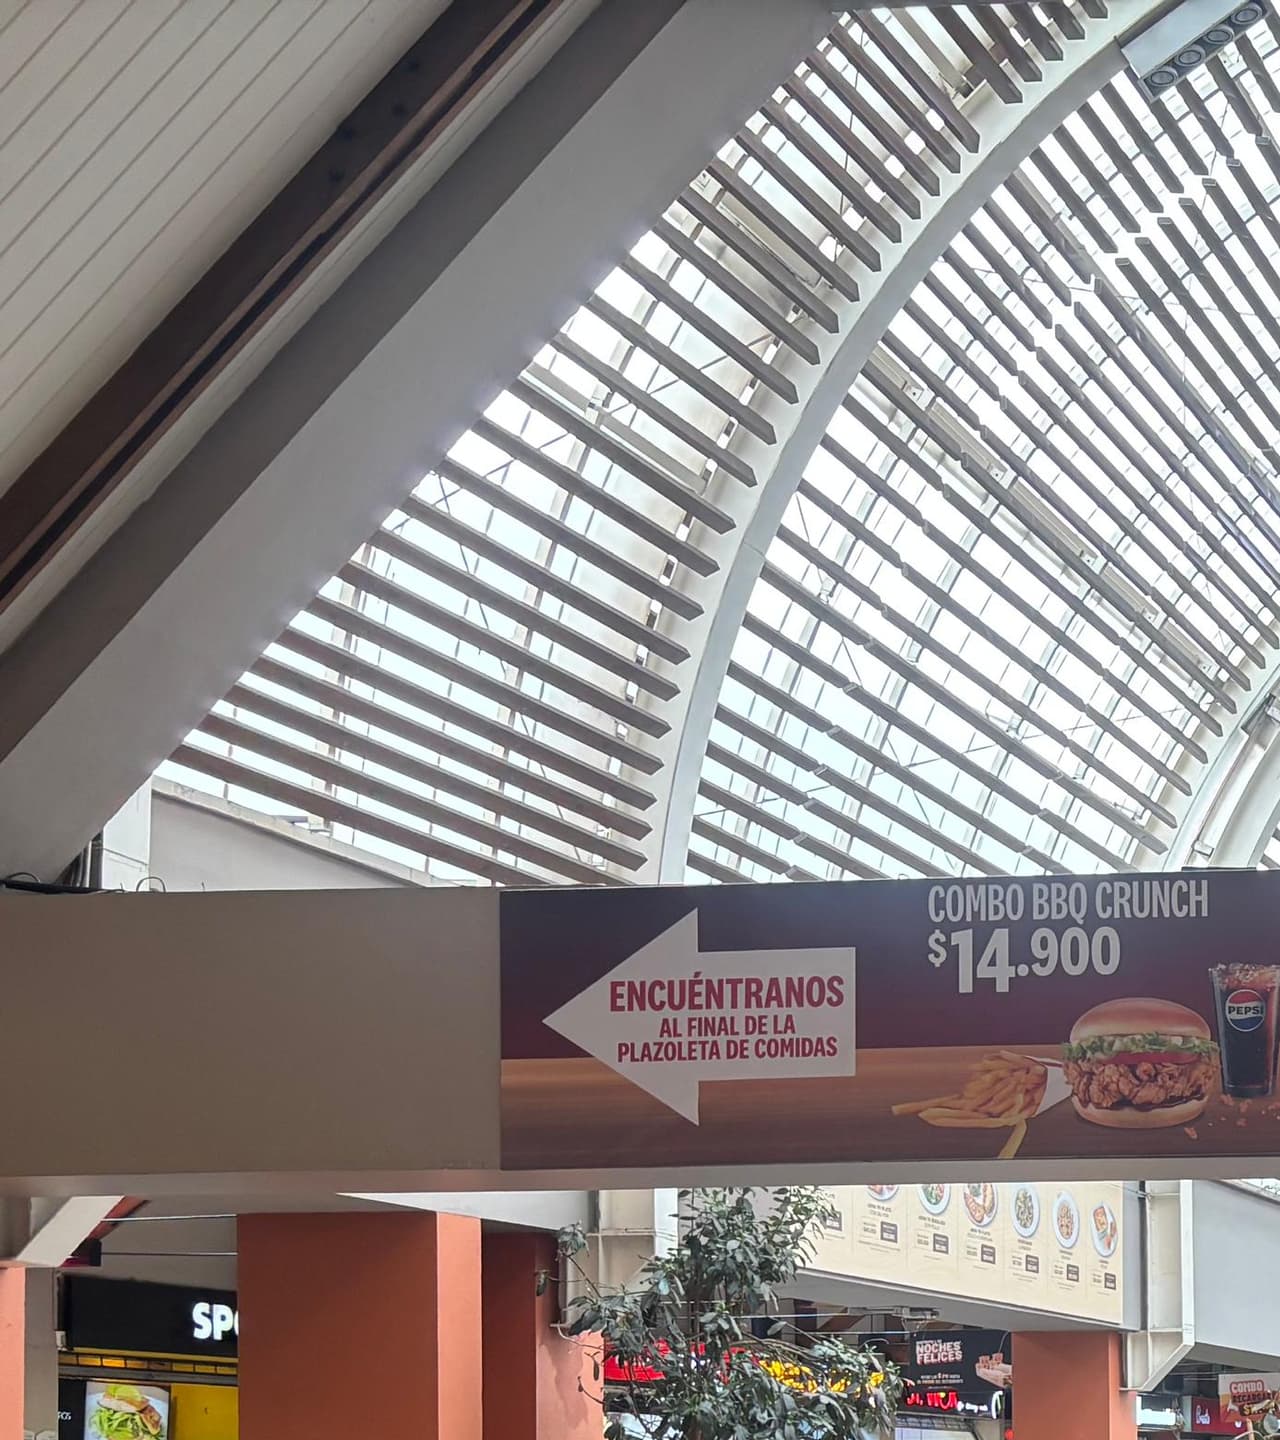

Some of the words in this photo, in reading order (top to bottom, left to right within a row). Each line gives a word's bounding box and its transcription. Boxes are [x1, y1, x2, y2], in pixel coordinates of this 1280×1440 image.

[928, 884, 1024, 923] COMBO
[1032, 882, 1088, 924] BBQ
[1095, 879, 1209, 919] CRUNCH
[928, 926, 1121, 994] $14.900
[609, 972, 845, 1012] ENCUÉNTRANOS
[1228, 1005, 1264, 1015] PEPSI
[659, 1017, 684, 1039] AL
[688, 1016, 741, 1038] FINAL
[746, 1015, 770, 1036] DE
[774, 1014, 796, 1035] LA
[617, 1040, 720, 1063] PLAZOLETA
[725, 1039, 750, 1060] DE
[754, 1036, 838, 1060] COMIDAS
[192, 1302, 238, 1341] SP
